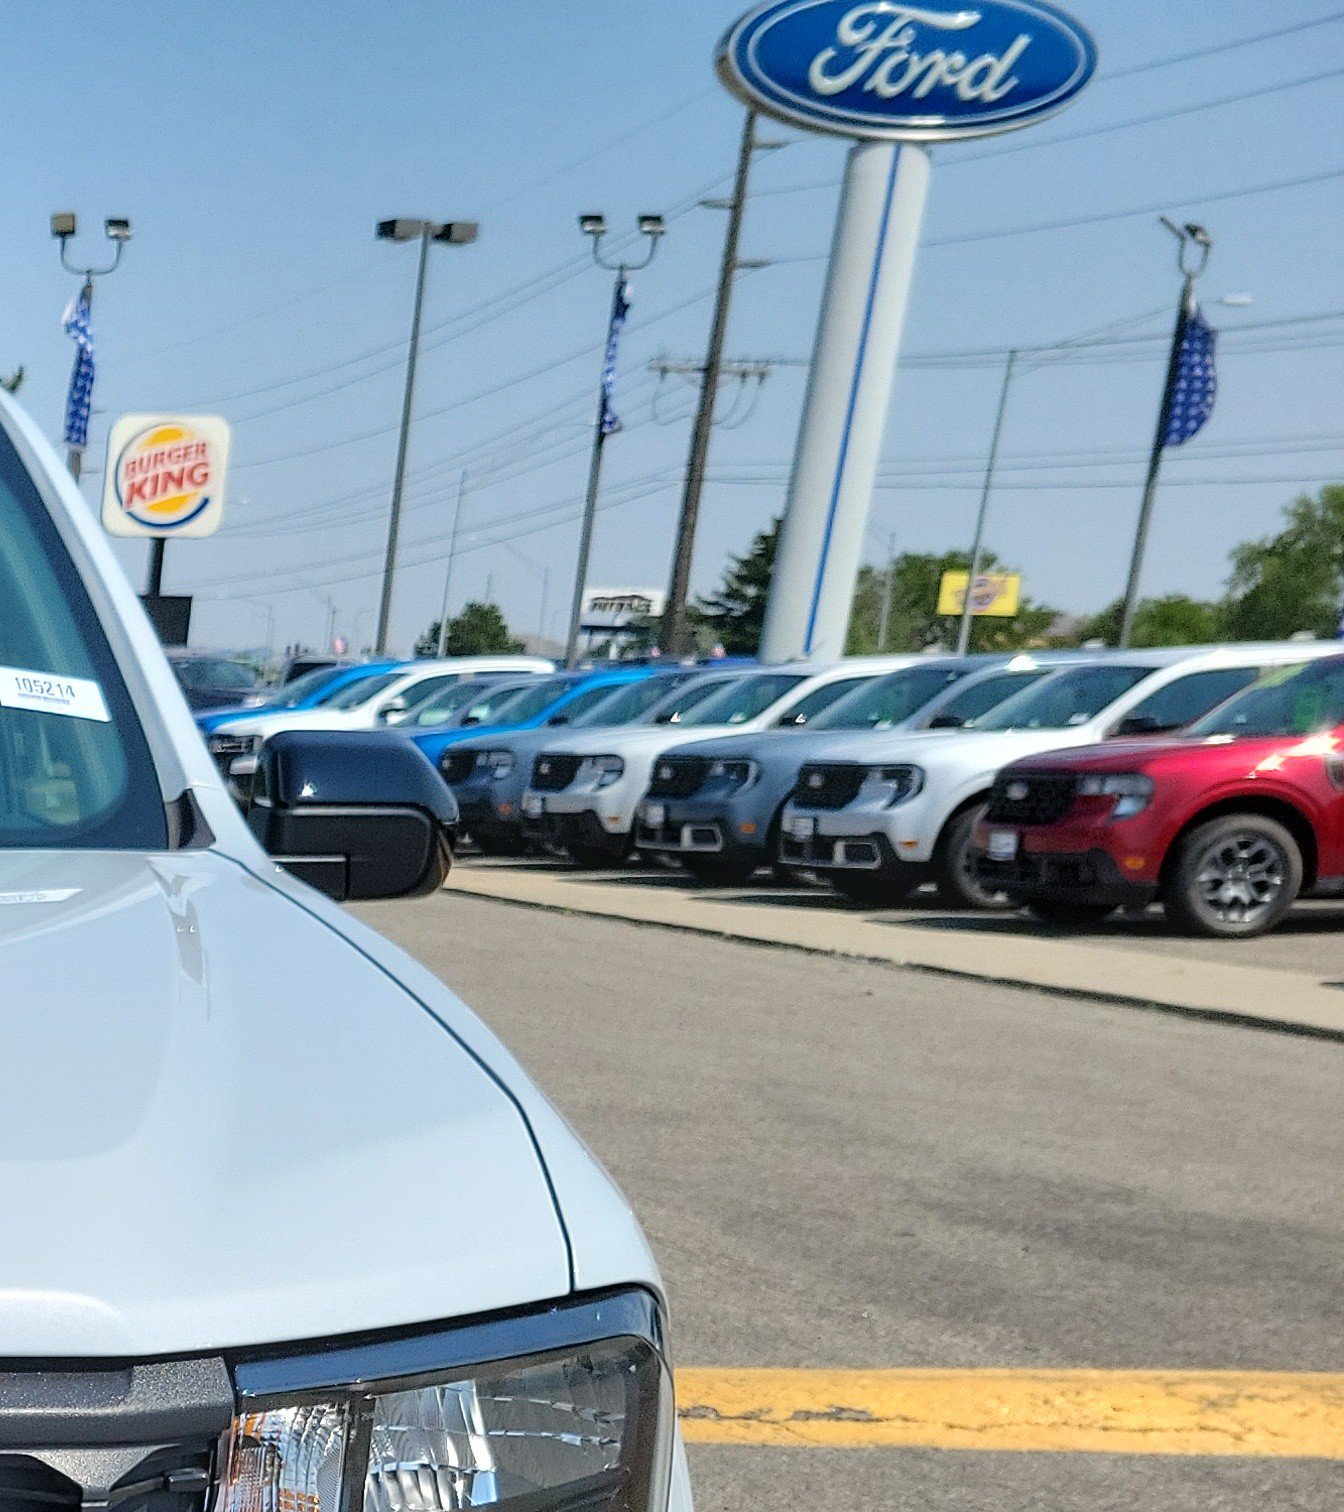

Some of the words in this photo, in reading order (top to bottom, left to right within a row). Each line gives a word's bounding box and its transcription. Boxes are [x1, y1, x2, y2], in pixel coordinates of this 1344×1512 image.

[807, 1, 1032, 103] Ford
[125, 442, 208, 479] BURGER
[124, 461, 210, 508] KING
[14, 676, 76, 699] 105214
